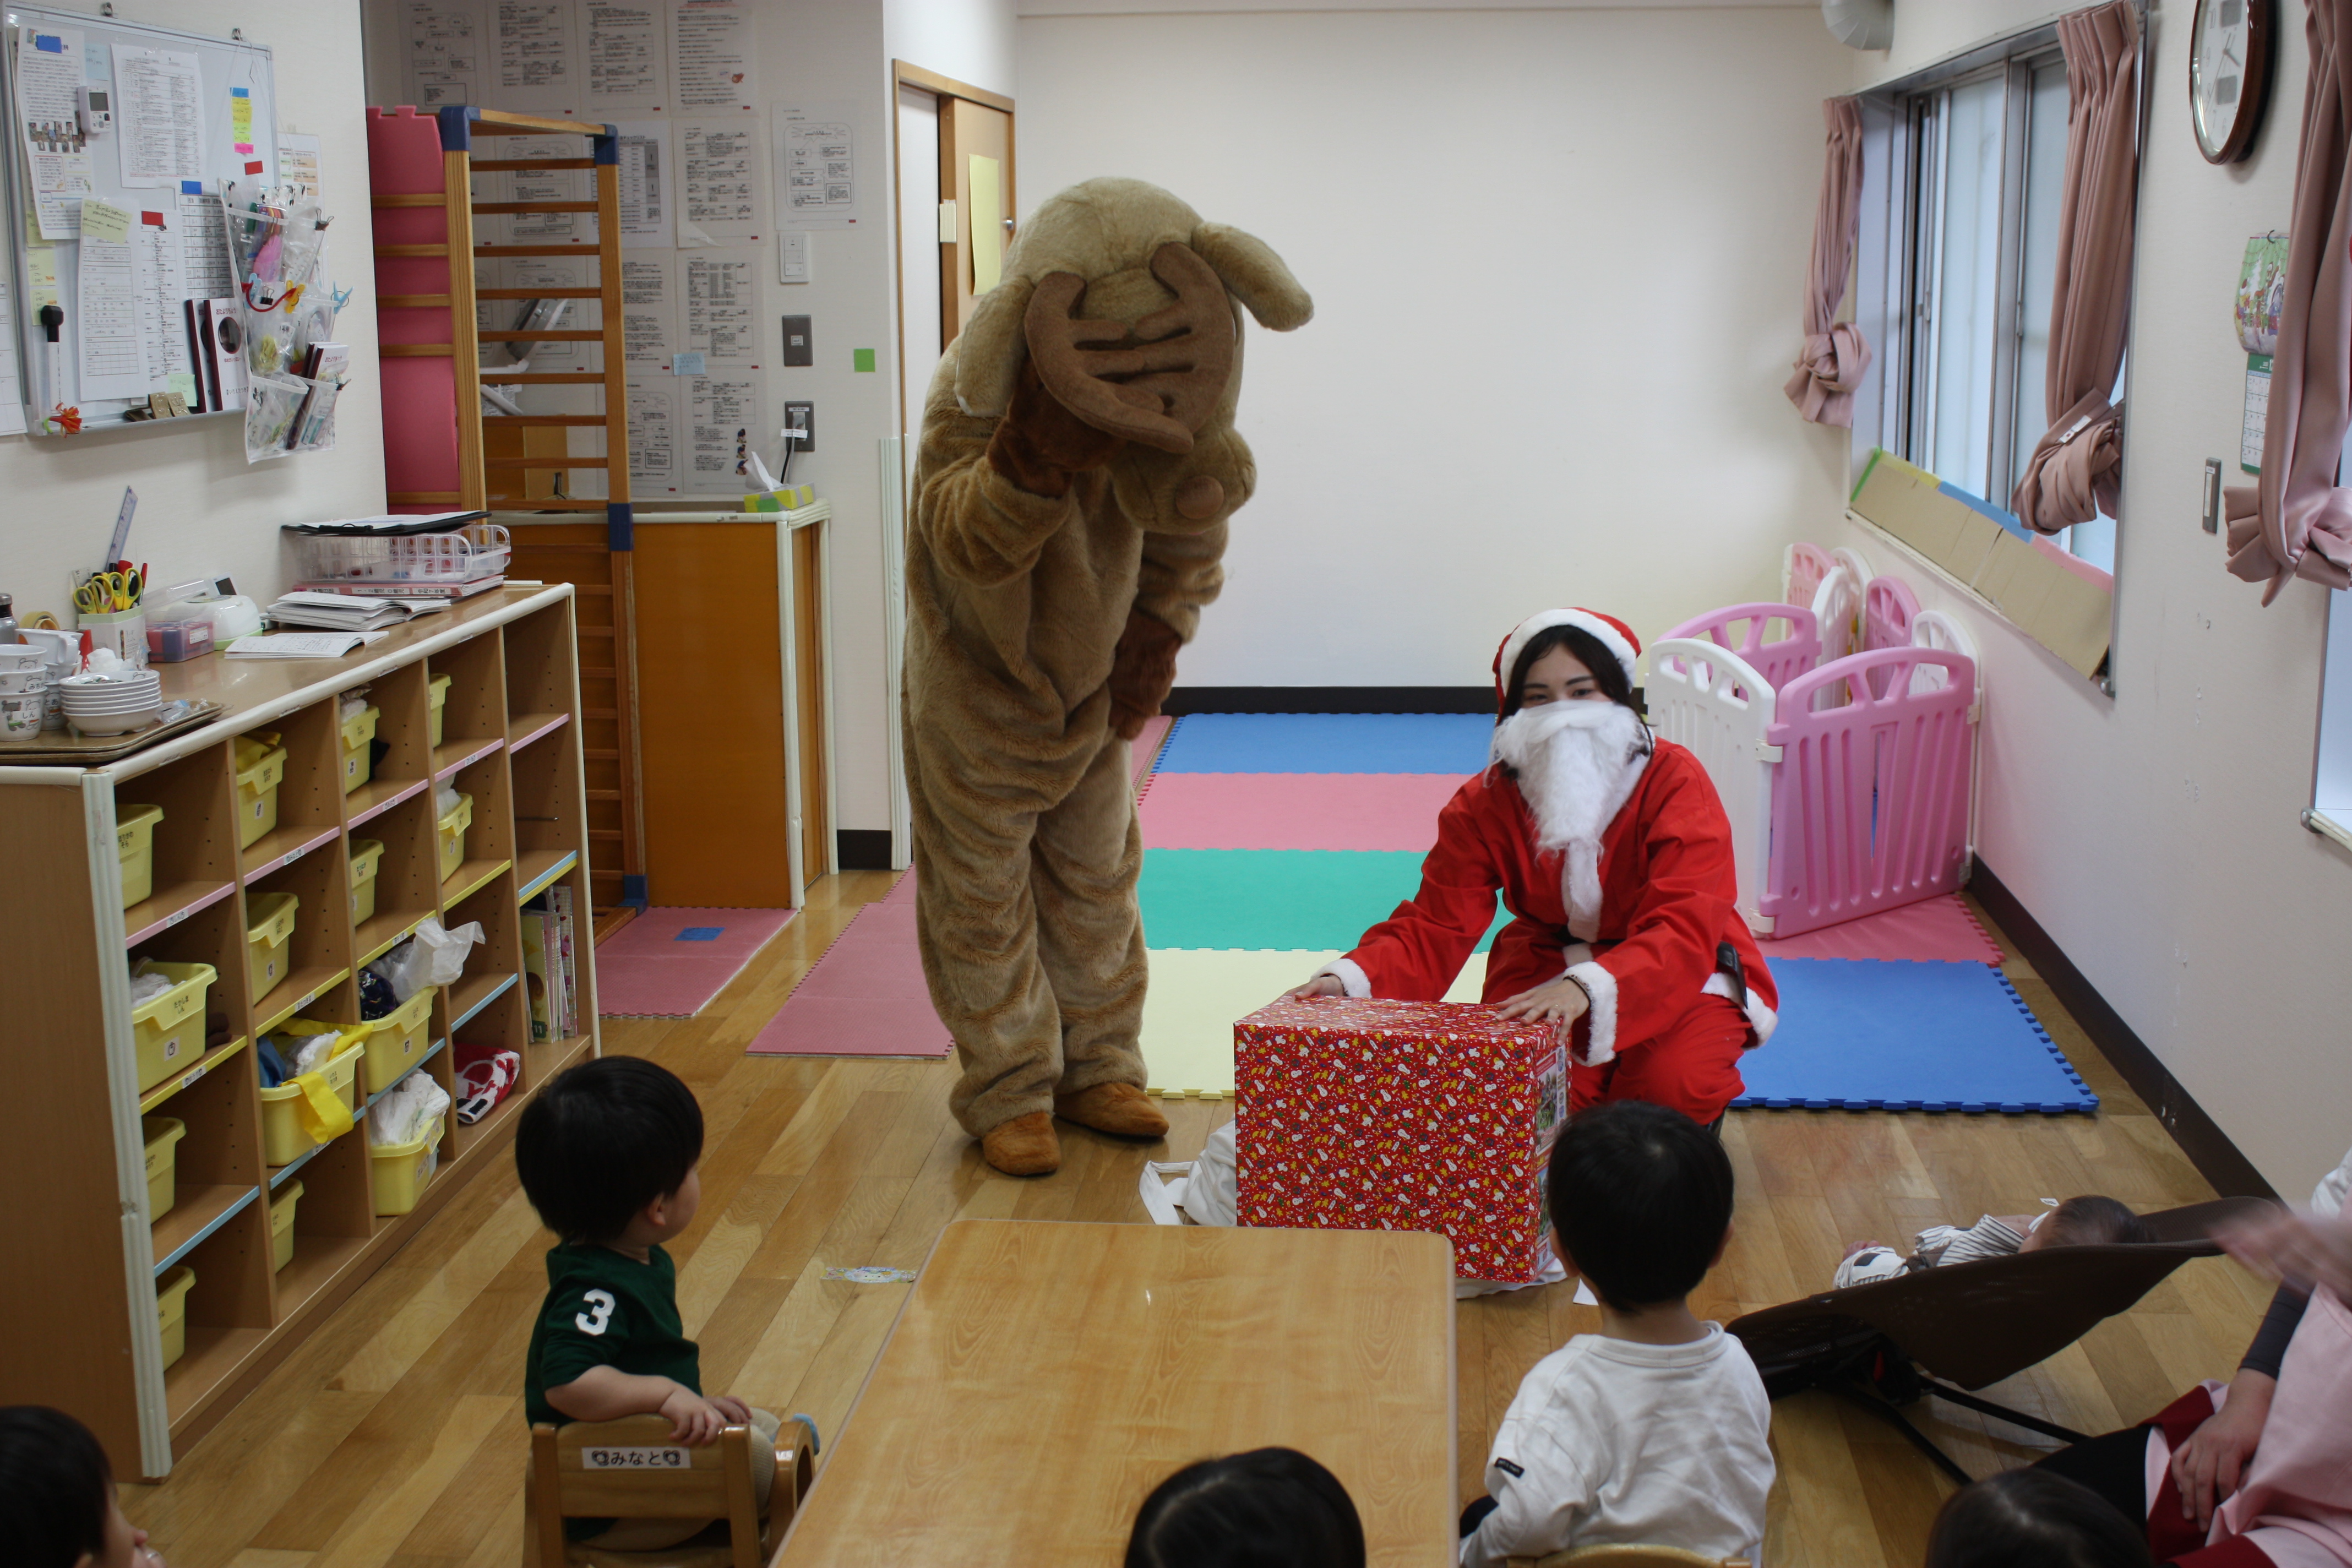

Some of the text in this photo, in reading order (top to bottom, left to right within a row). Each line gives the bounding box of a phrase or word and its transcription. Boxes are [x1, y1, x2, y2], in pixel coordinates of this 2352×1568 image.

[575, 1288, 616, 1336] 3
[611, 1451, 661, 1466] みなと
